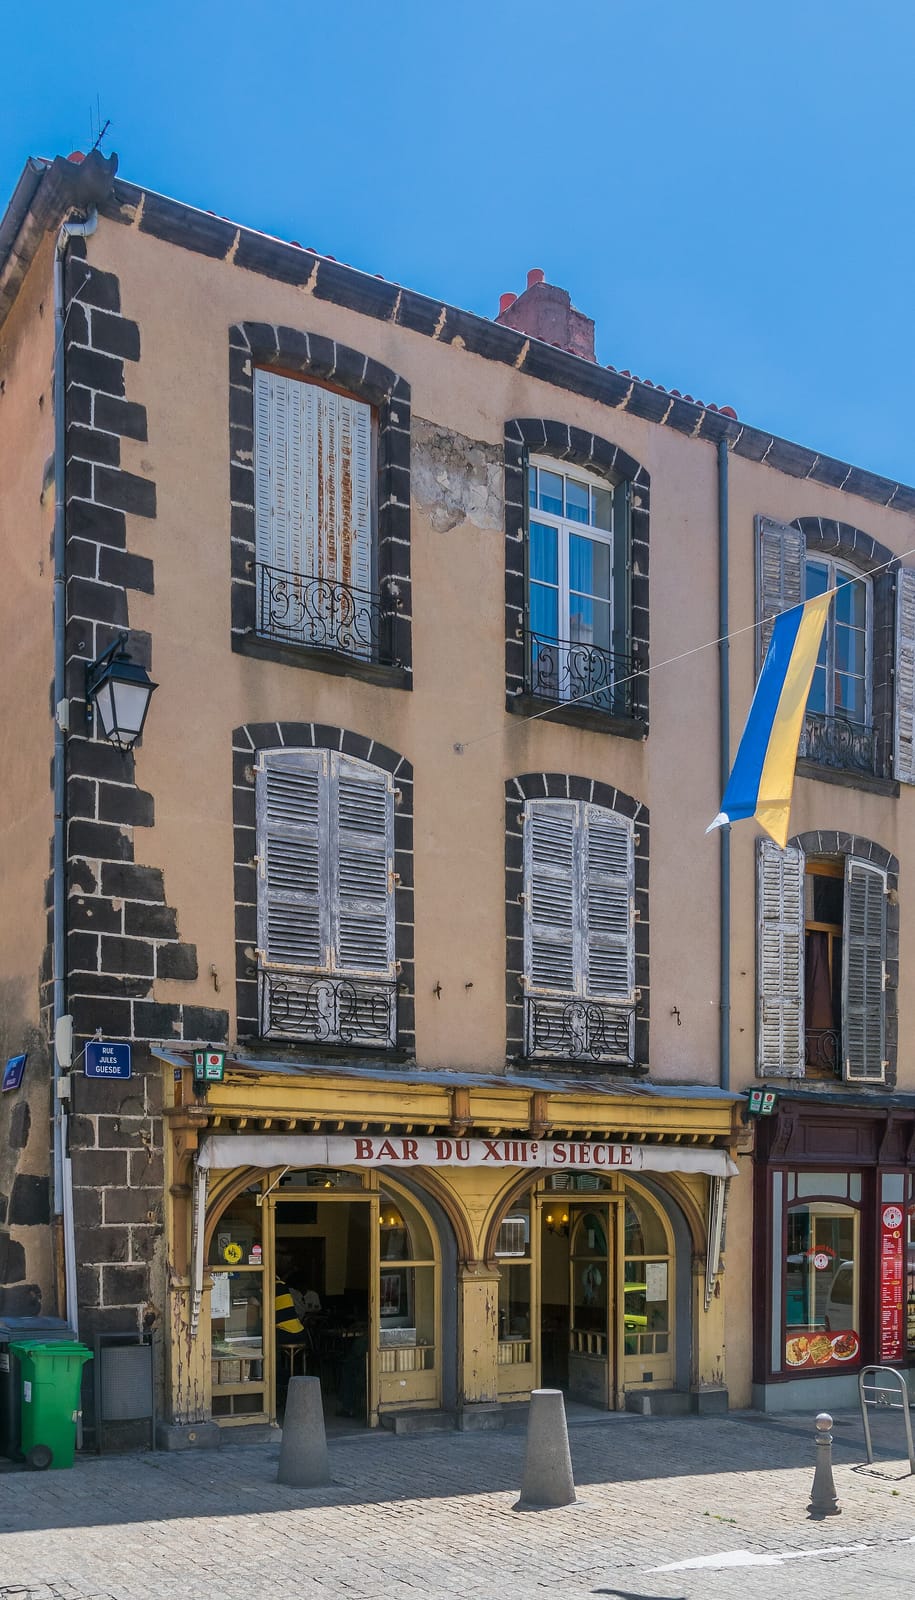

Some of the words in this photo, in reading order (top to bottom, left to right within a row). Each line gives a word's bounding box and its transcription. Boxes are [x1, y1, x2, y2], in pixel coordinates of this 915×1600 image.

[102, 1047, 114, 1055] RUE
[99, 1056, 118, 1064] JULES
[95, 1065, 121, 1074] GUESDE
[353, 1138, 419, 1160] BAR
[435, 1139, 471, 1161] DU
